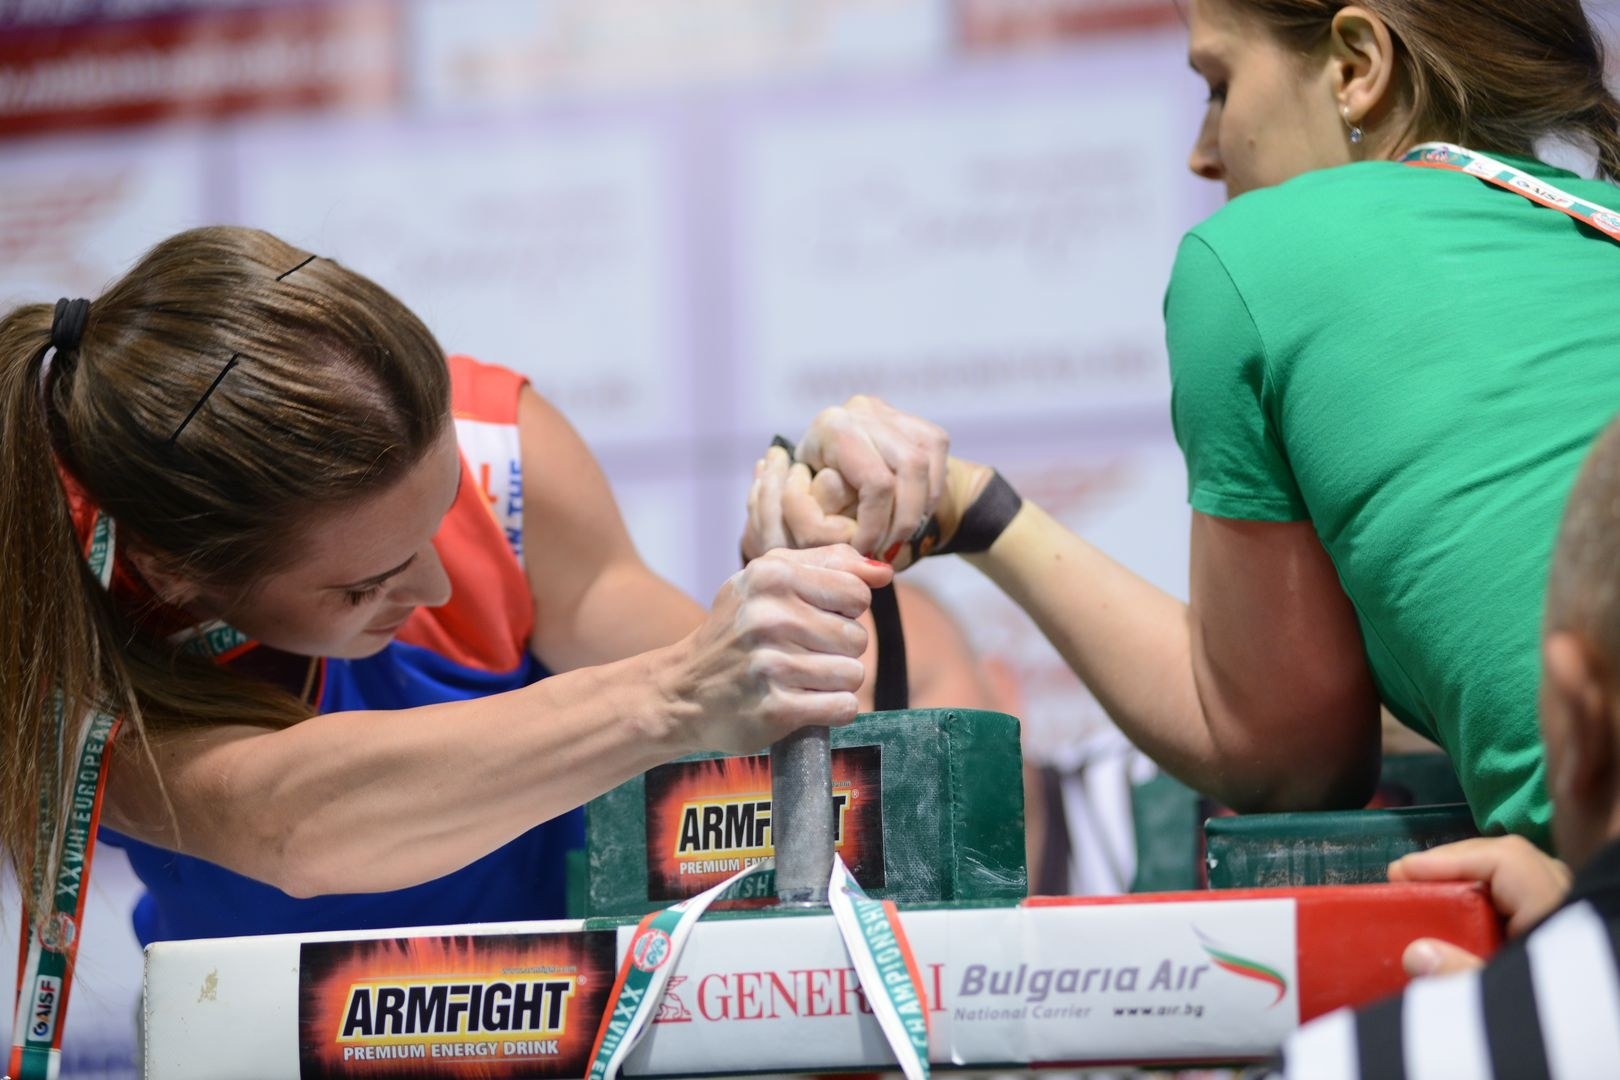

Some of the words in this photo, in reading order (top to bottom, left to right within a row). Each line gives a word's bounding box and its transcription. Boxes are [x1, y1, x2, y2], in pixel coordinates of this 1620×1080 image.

[679, 796, 847, 853] ARMFT
[679, 858, 740, 875] PREMIUM
[697, 962, 947, 1022] GENERI
[856, 898, 929, 1048] CHAMPIONSHI
[957, 963, 1140, 1003] Bulgaria
[1147, 959, 1211, 991] Air
[342, 981, 570, 1037] ARMFIGHT
[600, 982, 645, 1056] XXVIII
[953, 1006, 1027, 1022] National
[1031, 1004, 1093, 1020] Carrier
[1112, 1003, 1205, 1018] www.air.bg
[343, 1043, 426, 1061] PREMIUM
[431, 1041, 499, 1058] ENERGY
[503, 1039, 559, 1057] DRINK
